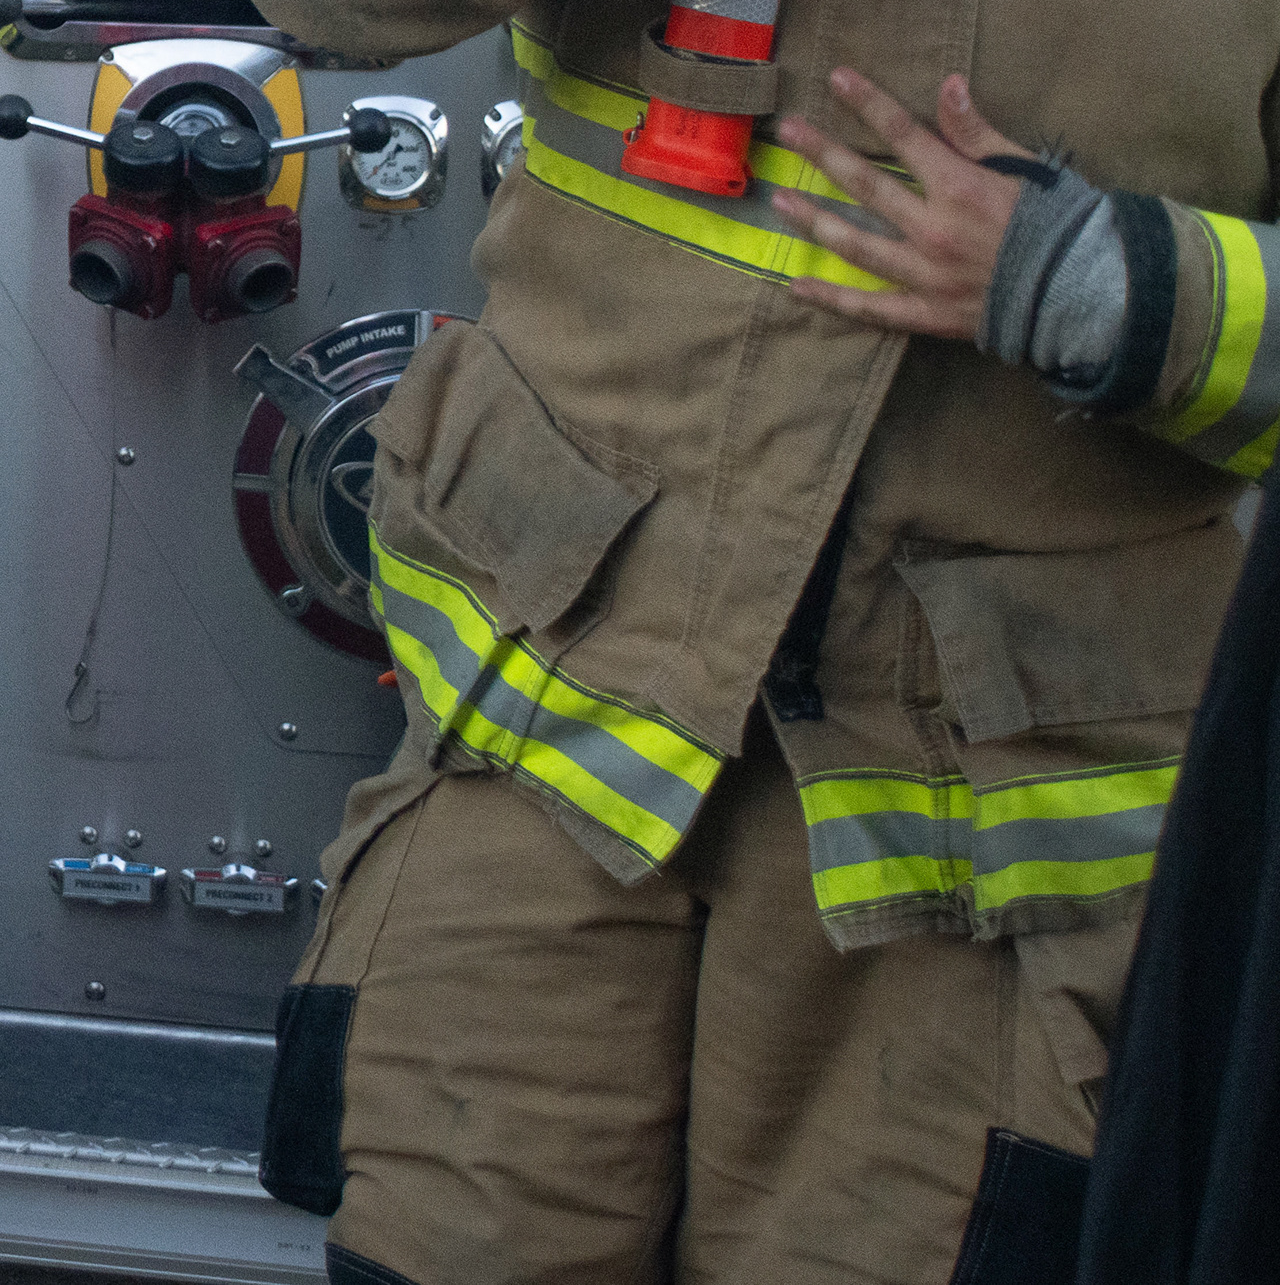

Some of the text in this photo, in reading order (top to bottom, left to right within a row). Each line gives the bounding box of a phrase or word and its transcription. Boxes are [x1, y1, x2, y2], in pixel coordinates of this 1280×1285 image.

[326, 324, 406, 358] PUMP INTAKE
[75, 879, 132, 891] PRECONNECT
[205, 889, 264, 901] PRECONNECT
